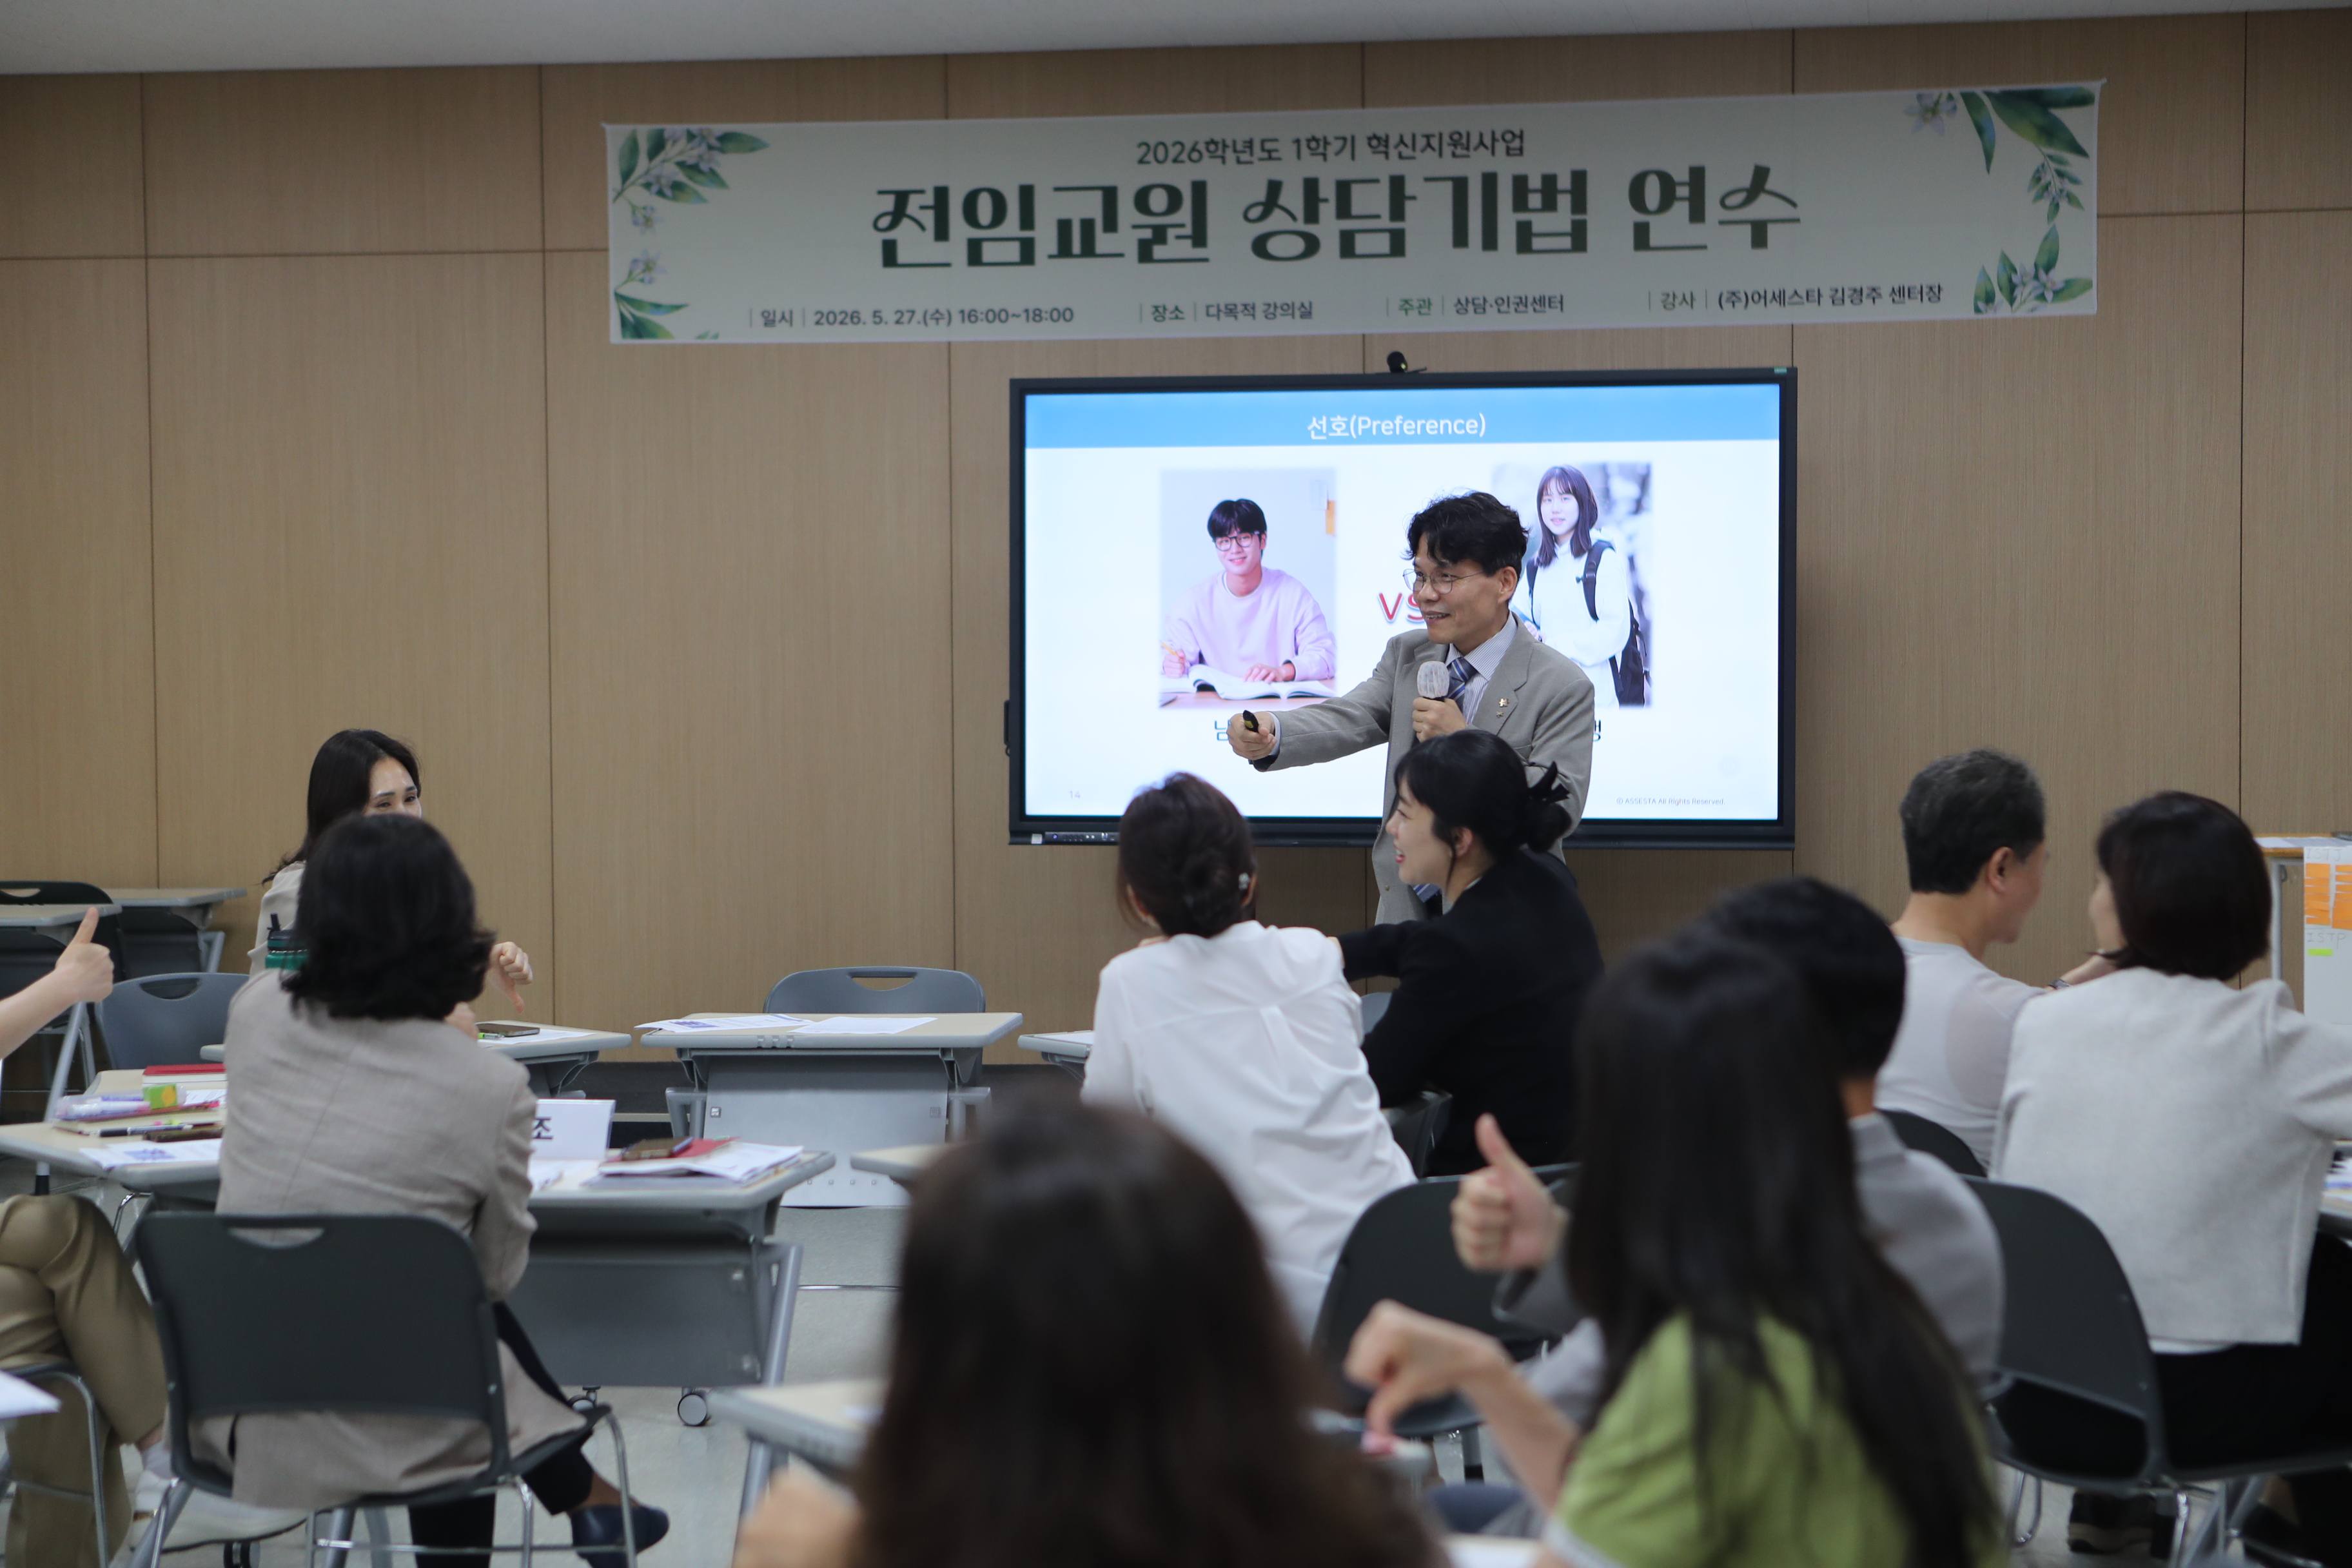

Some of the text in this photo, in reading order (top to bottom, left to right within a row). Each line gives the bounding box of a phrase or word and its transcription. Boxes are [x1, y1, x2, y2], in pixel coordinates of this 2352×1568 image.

[1136, 129, 1525, 166] 2026학년도 1학기 혁신지원사업
[872, 163, 1802, 269] 전임교원 상담기법 연수
[1398, 293, 1565, 317] 주관 상담·인권센터
[1660, 283, 1943, 311] 강사 (주)어세스타 김경주 센터장
[760, 306, 1075, 328] 일시 2026. 5. 27.(수) 16:00~18:00
[1151, 300, 1314, 323] 장소 다목적 강의실
[1307, 412, 1487, 440] 선호(Preference)
